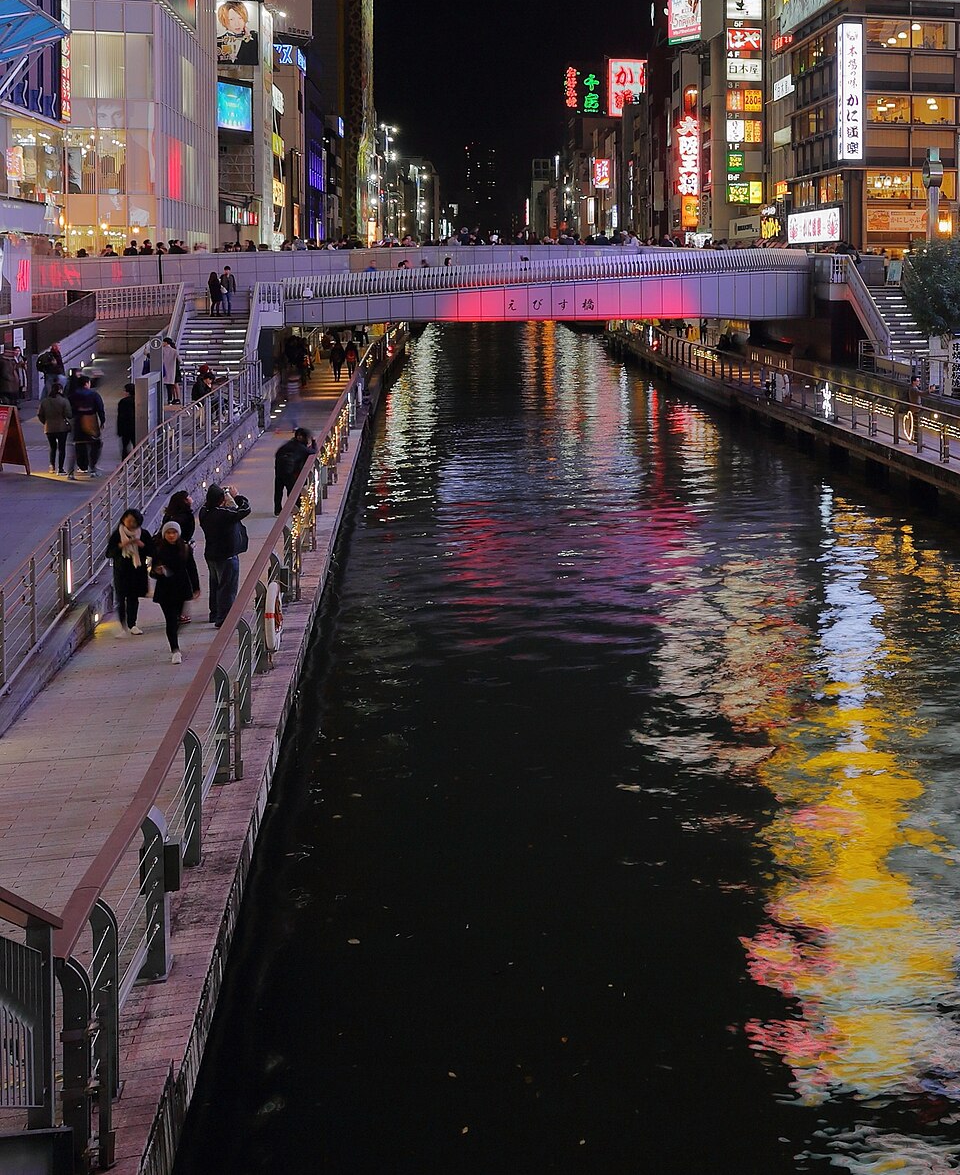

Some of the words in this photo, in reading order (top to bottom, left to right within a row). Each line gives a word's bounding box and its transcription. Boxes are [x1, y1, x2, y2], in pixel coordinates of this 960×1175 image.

[729, 62, 759, 74] 白木屋
[507, 298, 596, 312] えびす橋
